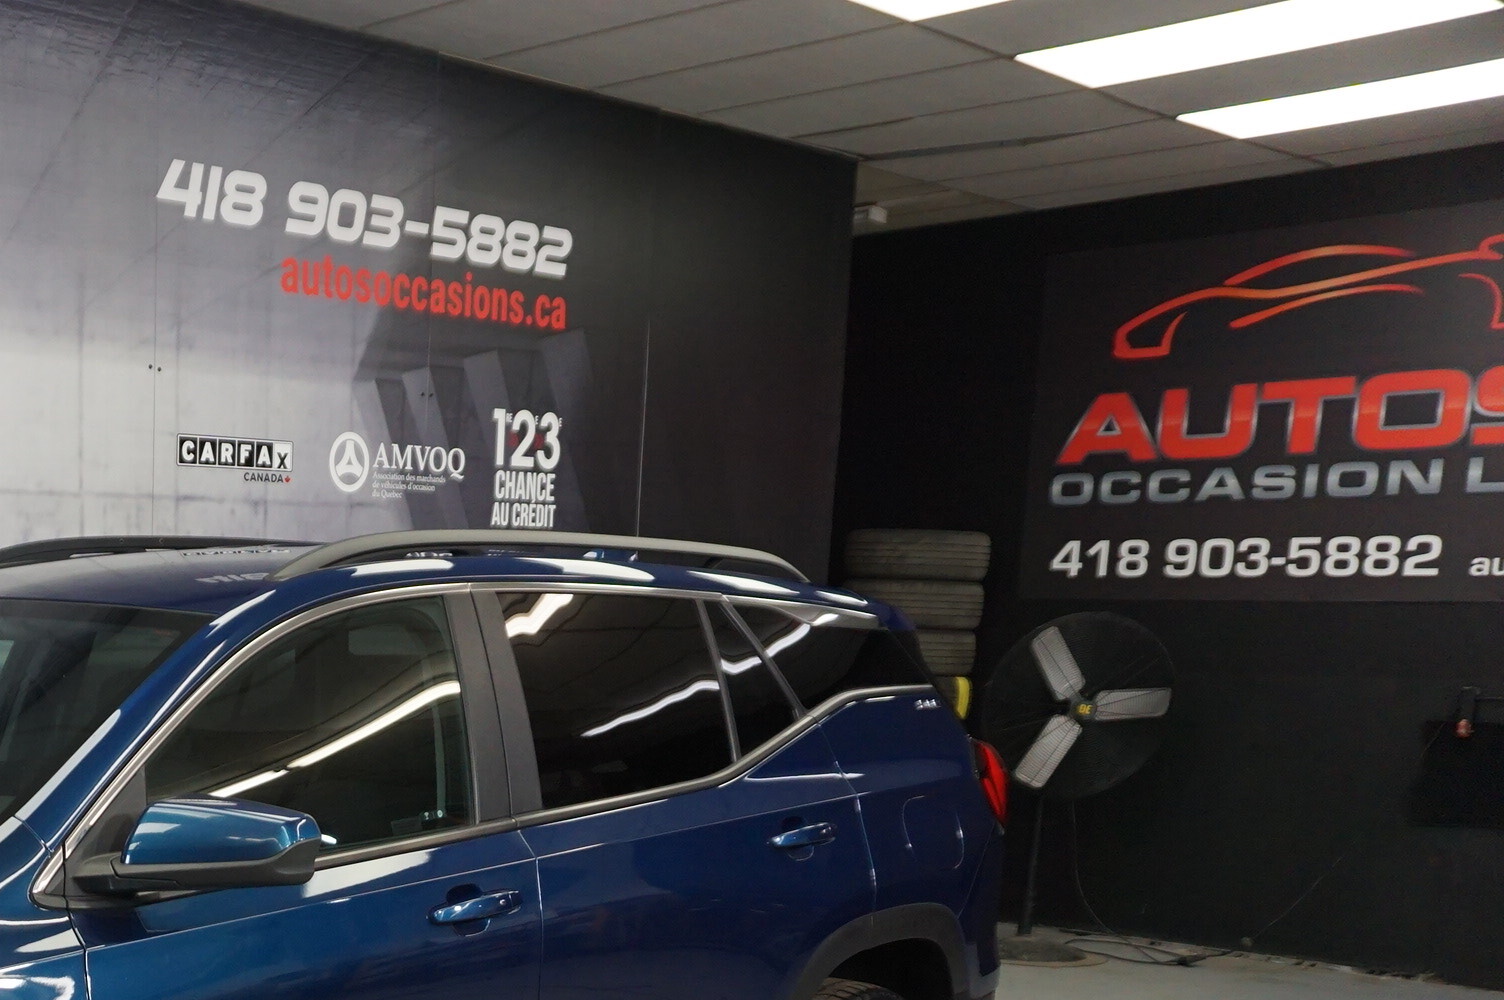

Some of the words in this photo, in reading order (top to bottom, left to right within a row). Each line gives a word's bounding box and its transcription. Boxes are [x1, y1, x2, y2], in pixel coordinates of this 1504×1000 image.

[156, 158, 268, 227] 418
[284, 180, 573, 279] 903-5882
[280, 254, 567, 330] autosoccasions.ca
[181, 439, 289, 469] CARFAX
[372, 442, 466, 480] AMVOQ
[243, 472, 284, 483] CANADA
[495, 469, 556, 501] CHANCE
[1049, 457, 1445, 506] OCCASION
[491, 501, 510, 526] AU
[1049, 538, 1150, 579] 418
[1163, 534, 1443, 579] 903-5882
